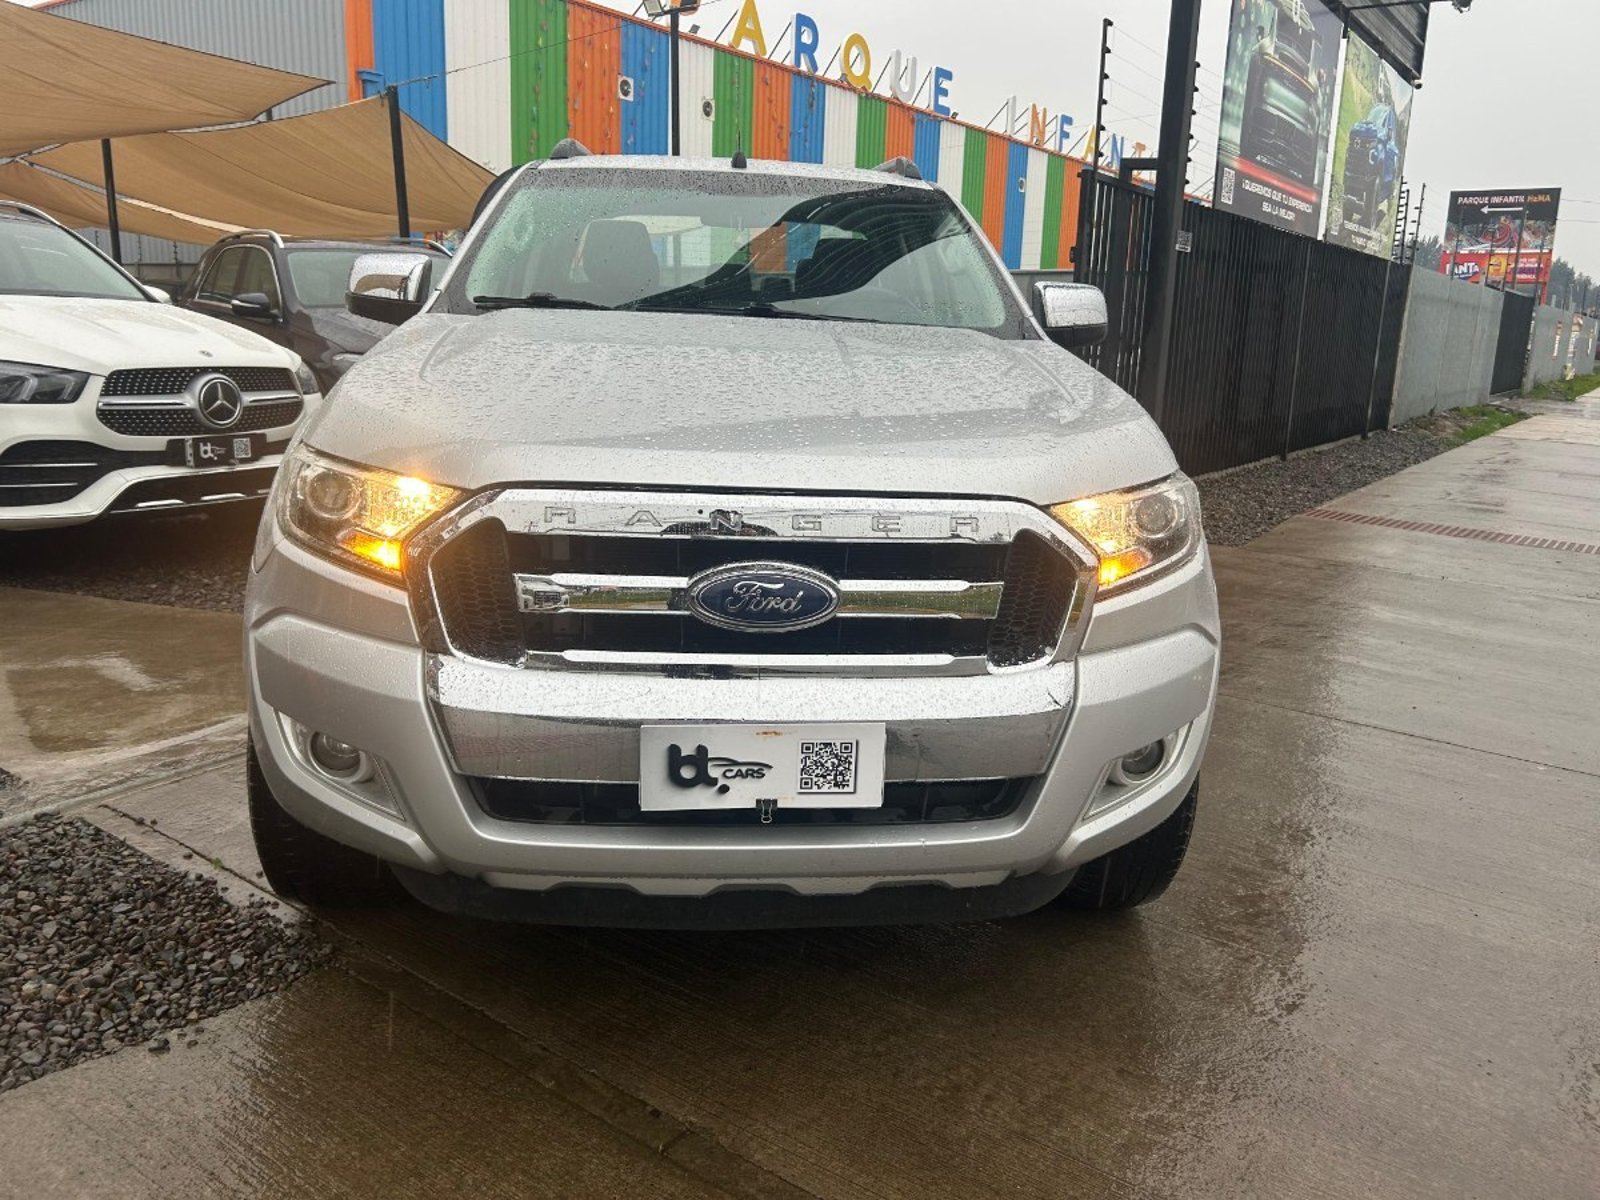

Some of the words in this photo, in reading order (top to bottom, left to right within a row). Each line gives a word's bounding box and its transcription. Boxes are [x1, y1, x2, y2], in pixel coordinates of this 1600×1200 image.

[1457, 196, 1489, 205] PARQUE
[1490, 195, 1524, 204] INFANTIL
[543, 505, 981, 533] RANGER
[725, 580, 804, 613] Ford
[722, 768, 766, 780] CARS
